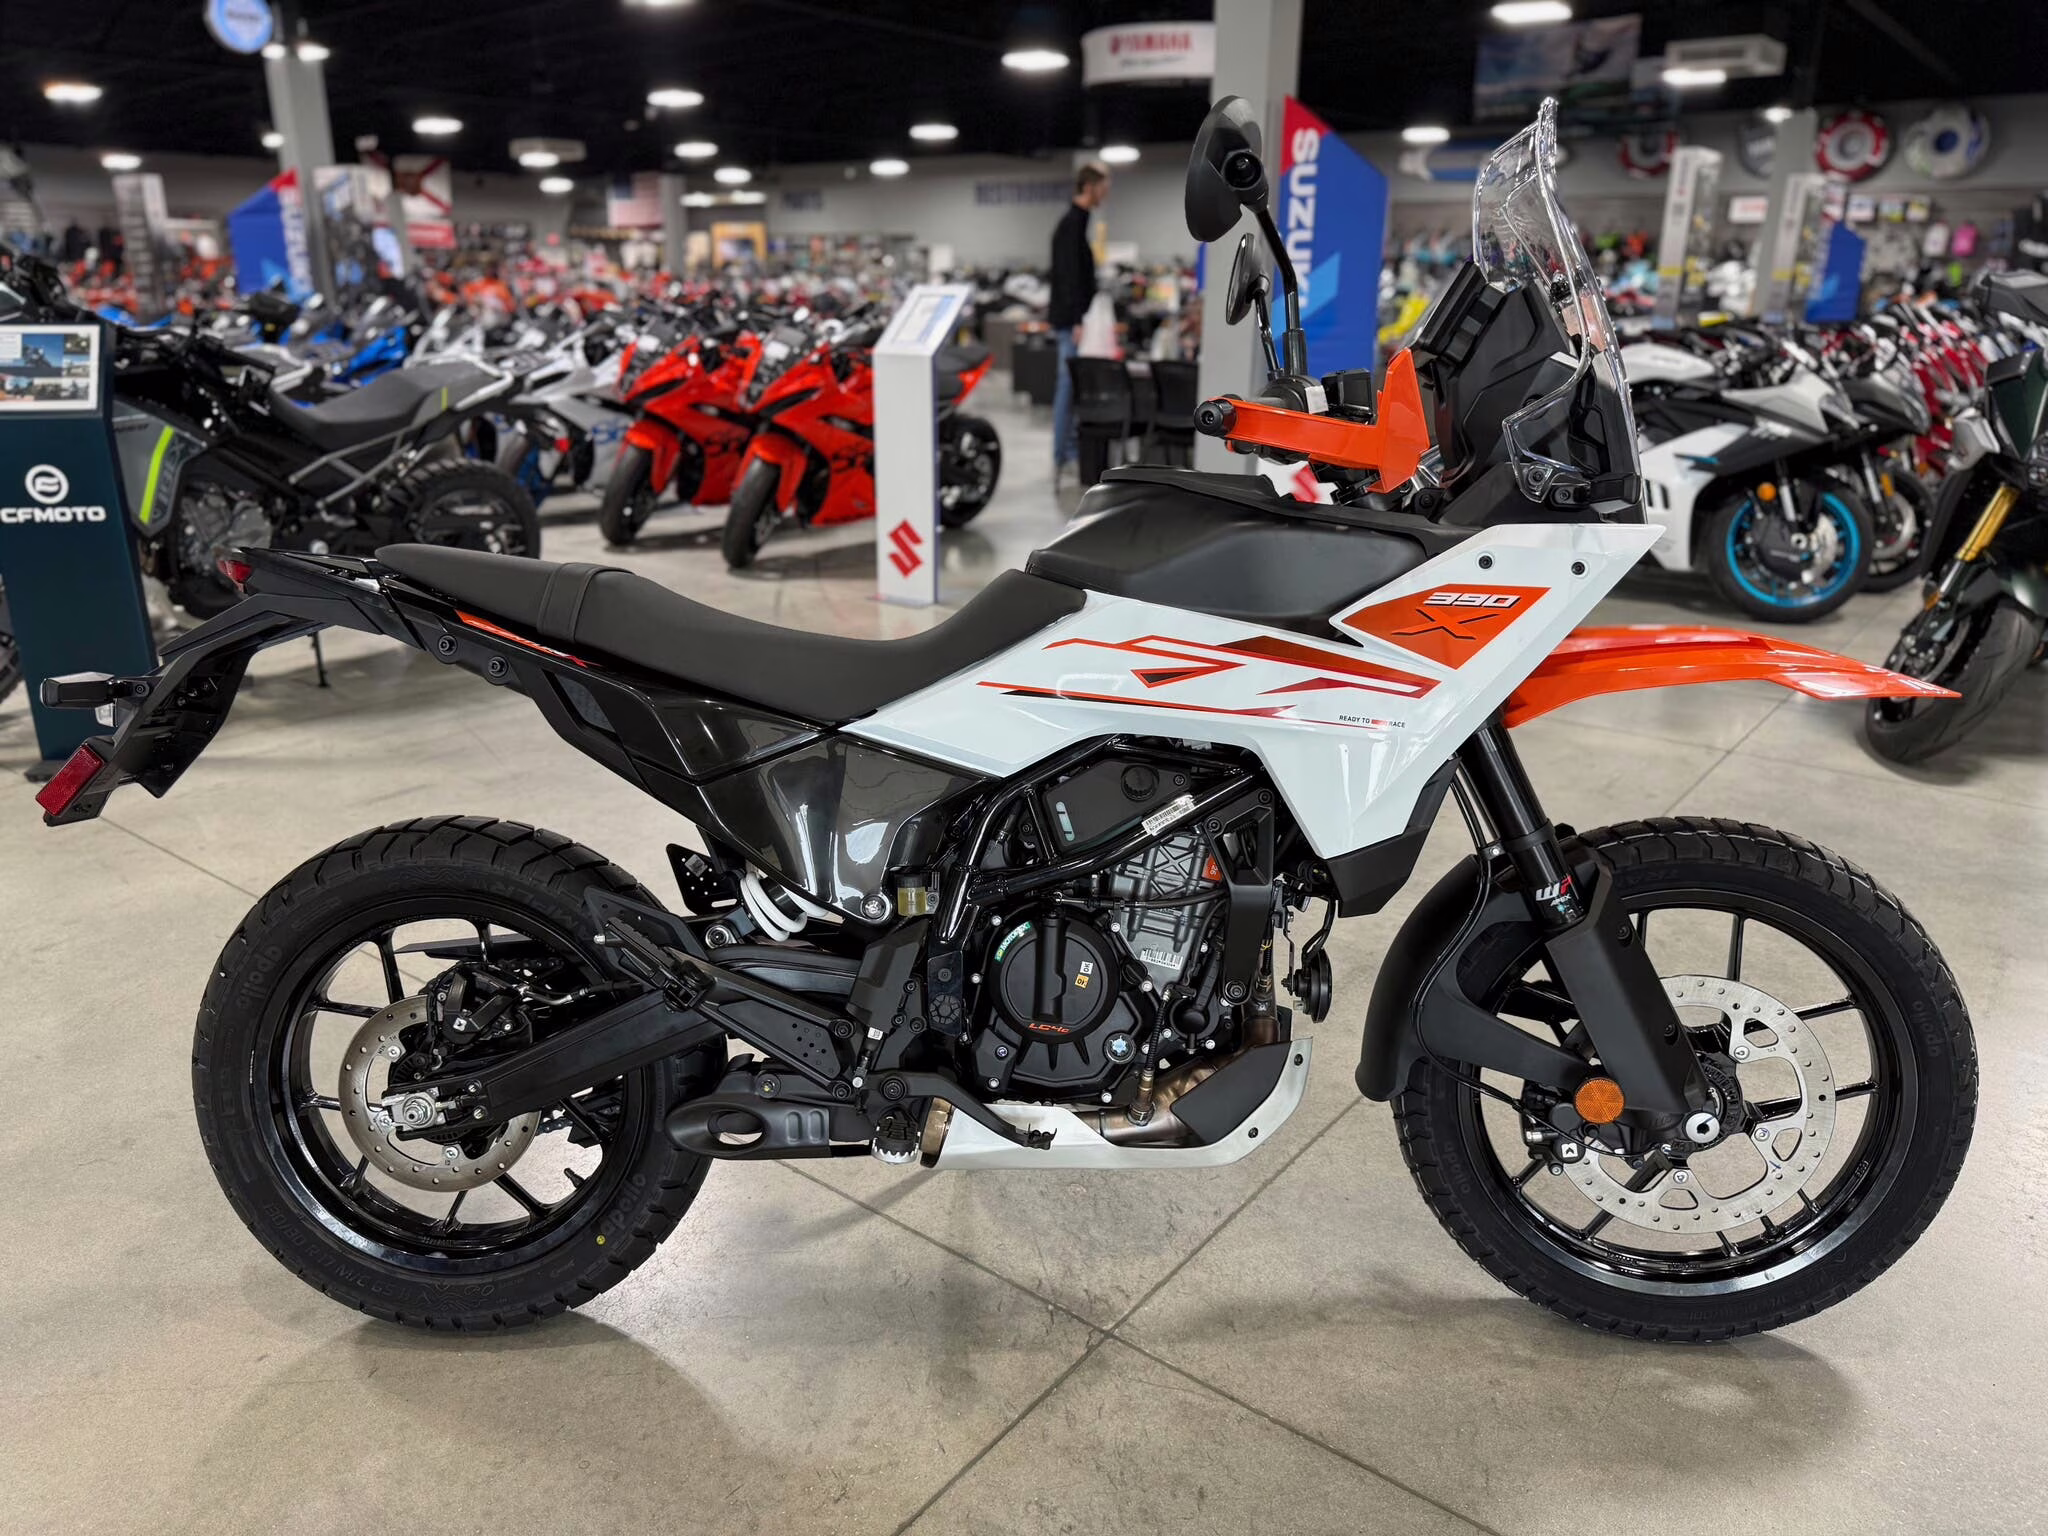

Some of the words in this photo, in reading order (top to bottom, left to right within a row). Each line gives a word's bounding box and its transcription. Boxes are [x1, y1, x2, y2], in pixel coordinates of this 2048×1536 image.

[1, 506, 106, 523] CFMOTO
[1423, 592, 1521, 609] 390
[1391, 607, 1501, 640] X
[1339, 714, 1360, 722] READY
[1536, 875, 1572, 901] WP
[1083, 962, 1090, 973] OK
[600, 1174, 646, 1236] apollo
